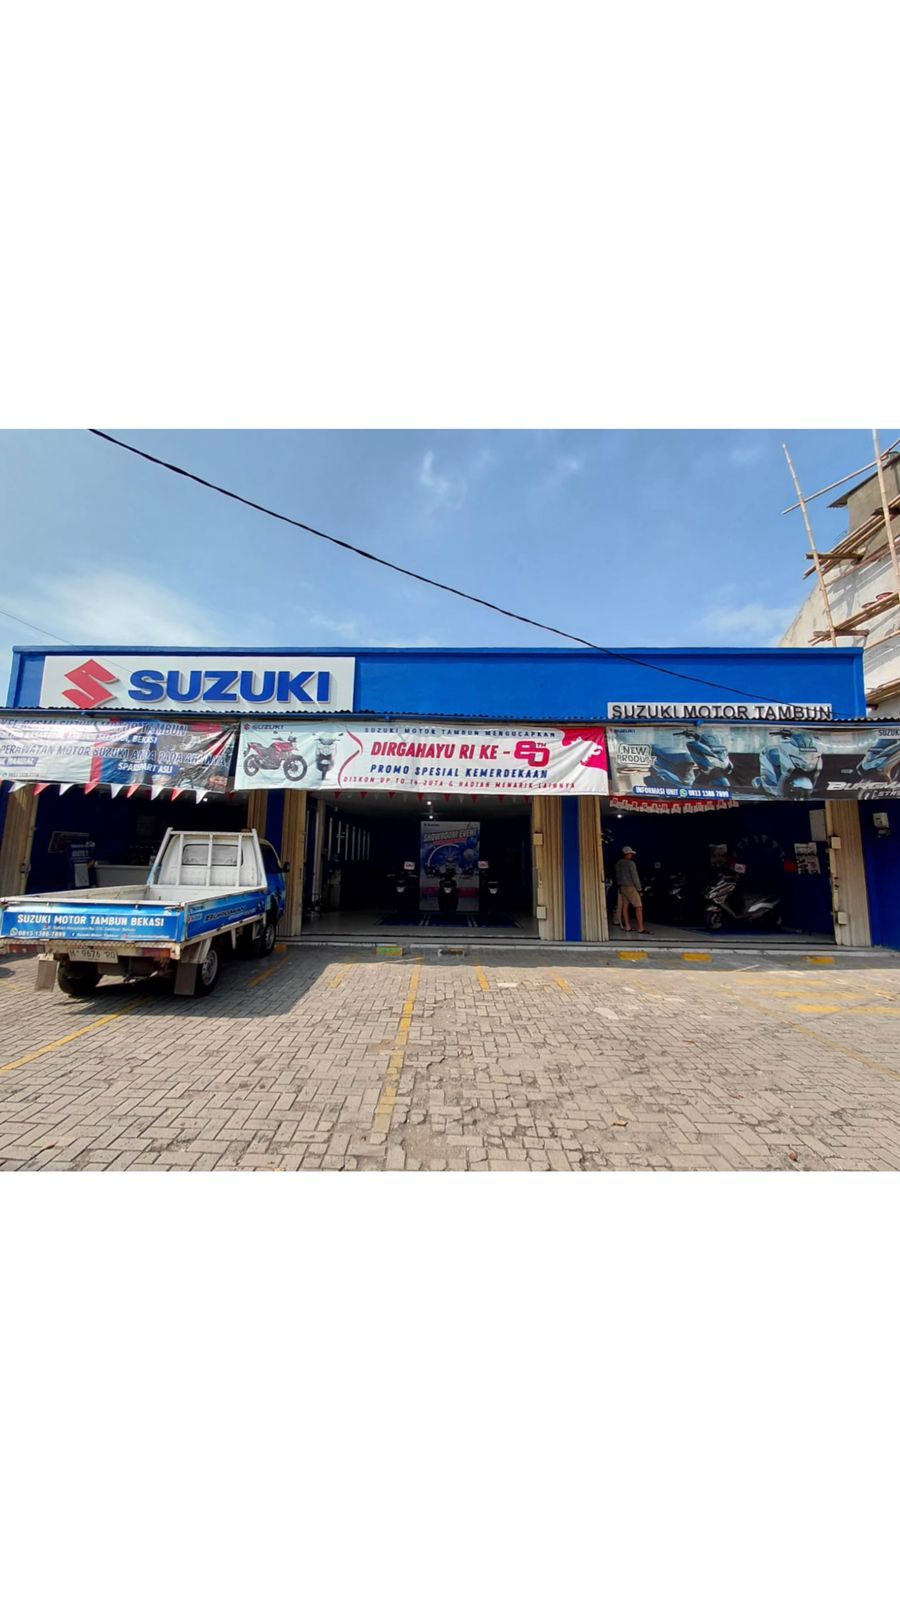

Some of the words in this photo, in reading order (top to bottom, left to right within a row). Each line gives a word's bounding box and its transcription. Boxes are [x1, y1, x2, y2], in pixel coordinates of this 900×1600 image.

[128, 670, 331, 704] SUZUKI
[612, 705, 677, 719] SUZUKI
[683, 706, 748, 719] MOTOR
[755, 706, 831, 720] TAMBUN
[56, 746, 91, 757] MOTOR
[93, 748, 129, 759] SUZUKI
[371, 741, 456, 759] DIRGAHAYU
[459, 744, 476, 760] RI
[479, 745, 499, 760] KE
[623, 746, 647, 756] NEW
[370, 764, 410, 774] PROMO
[415, 766, 460, 777] SPESIAL
[465, 768, 548, 779] KEMERDEKAAN
[636, 786, 665, 795] INFORMASI
[666, 788, 679, 796] UNIT
[17, 914, 51, 924] SUZUKI
[54, 915, 86, 925] MOTOR
[90, 916, 128, 926] TAMBUN
[131, 917, 164, 927] BEKASI
